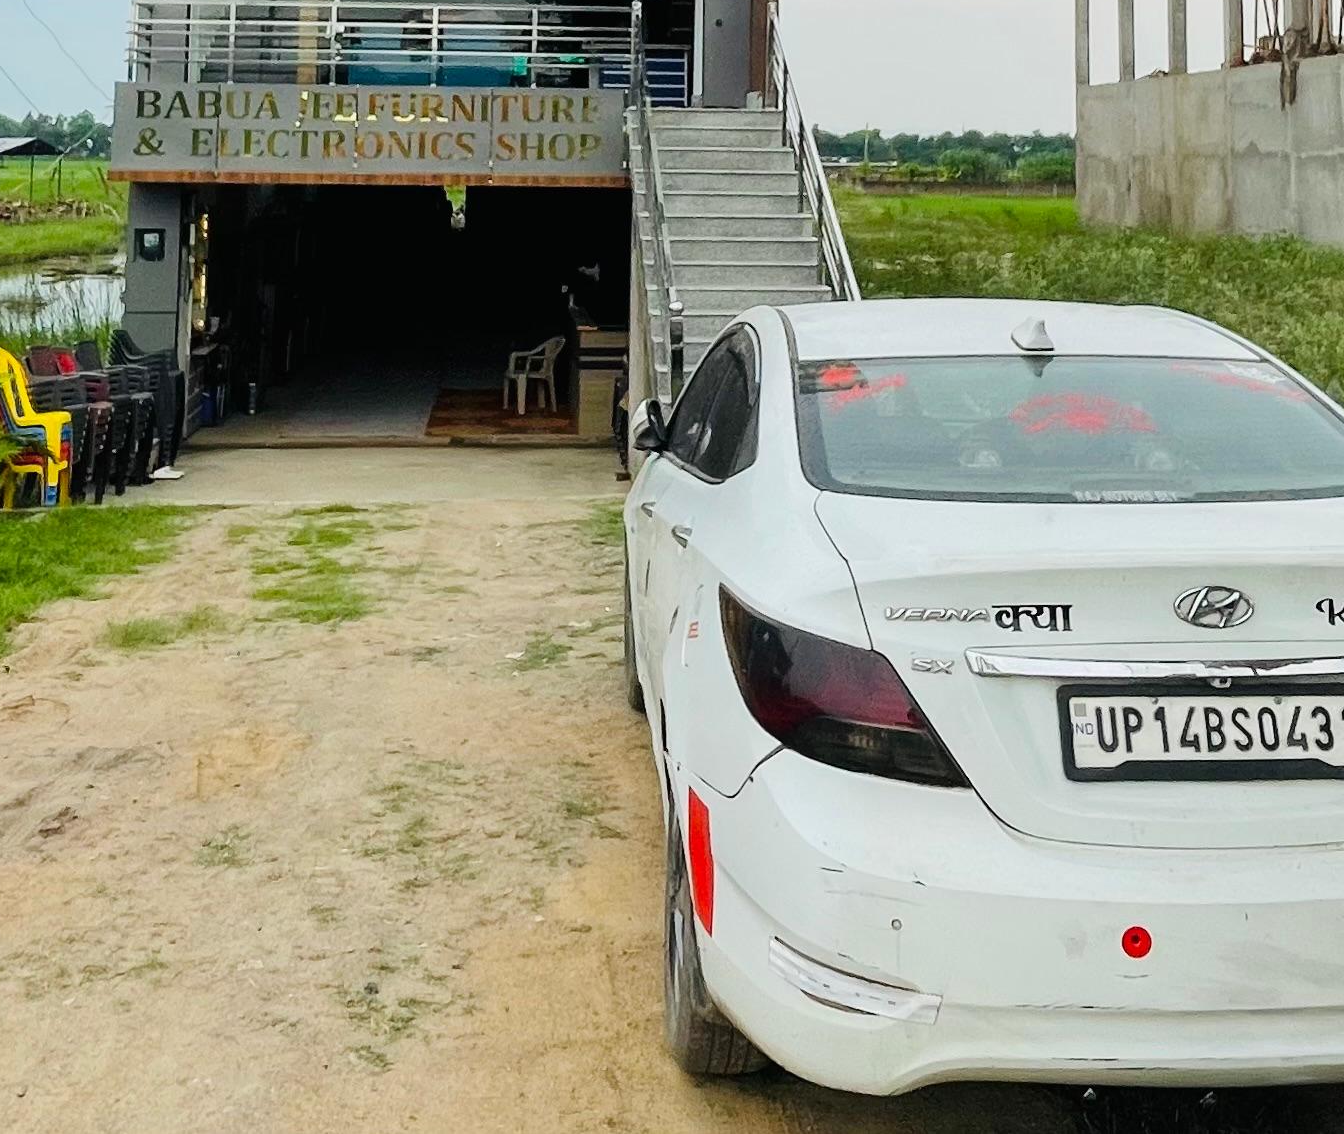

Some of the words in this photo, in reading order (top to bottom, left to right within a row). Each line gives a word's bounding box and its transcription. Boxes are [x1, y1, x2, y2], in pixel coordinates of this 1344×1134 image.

[134, 90, 277, 121] BABUA
[294, 91, 357, 129] JEE
[368, 92, 600, 124] FURNITURE
[133, 130, 165, 156] &
[190, 128, 476, 162] ELECTRONICS
[495, 132, 601, 162] SHOP
[885, 606, 991, 623] VERNA
[991, 604, 1073, 632] क्या
[911, 658, 955, 675] SX
